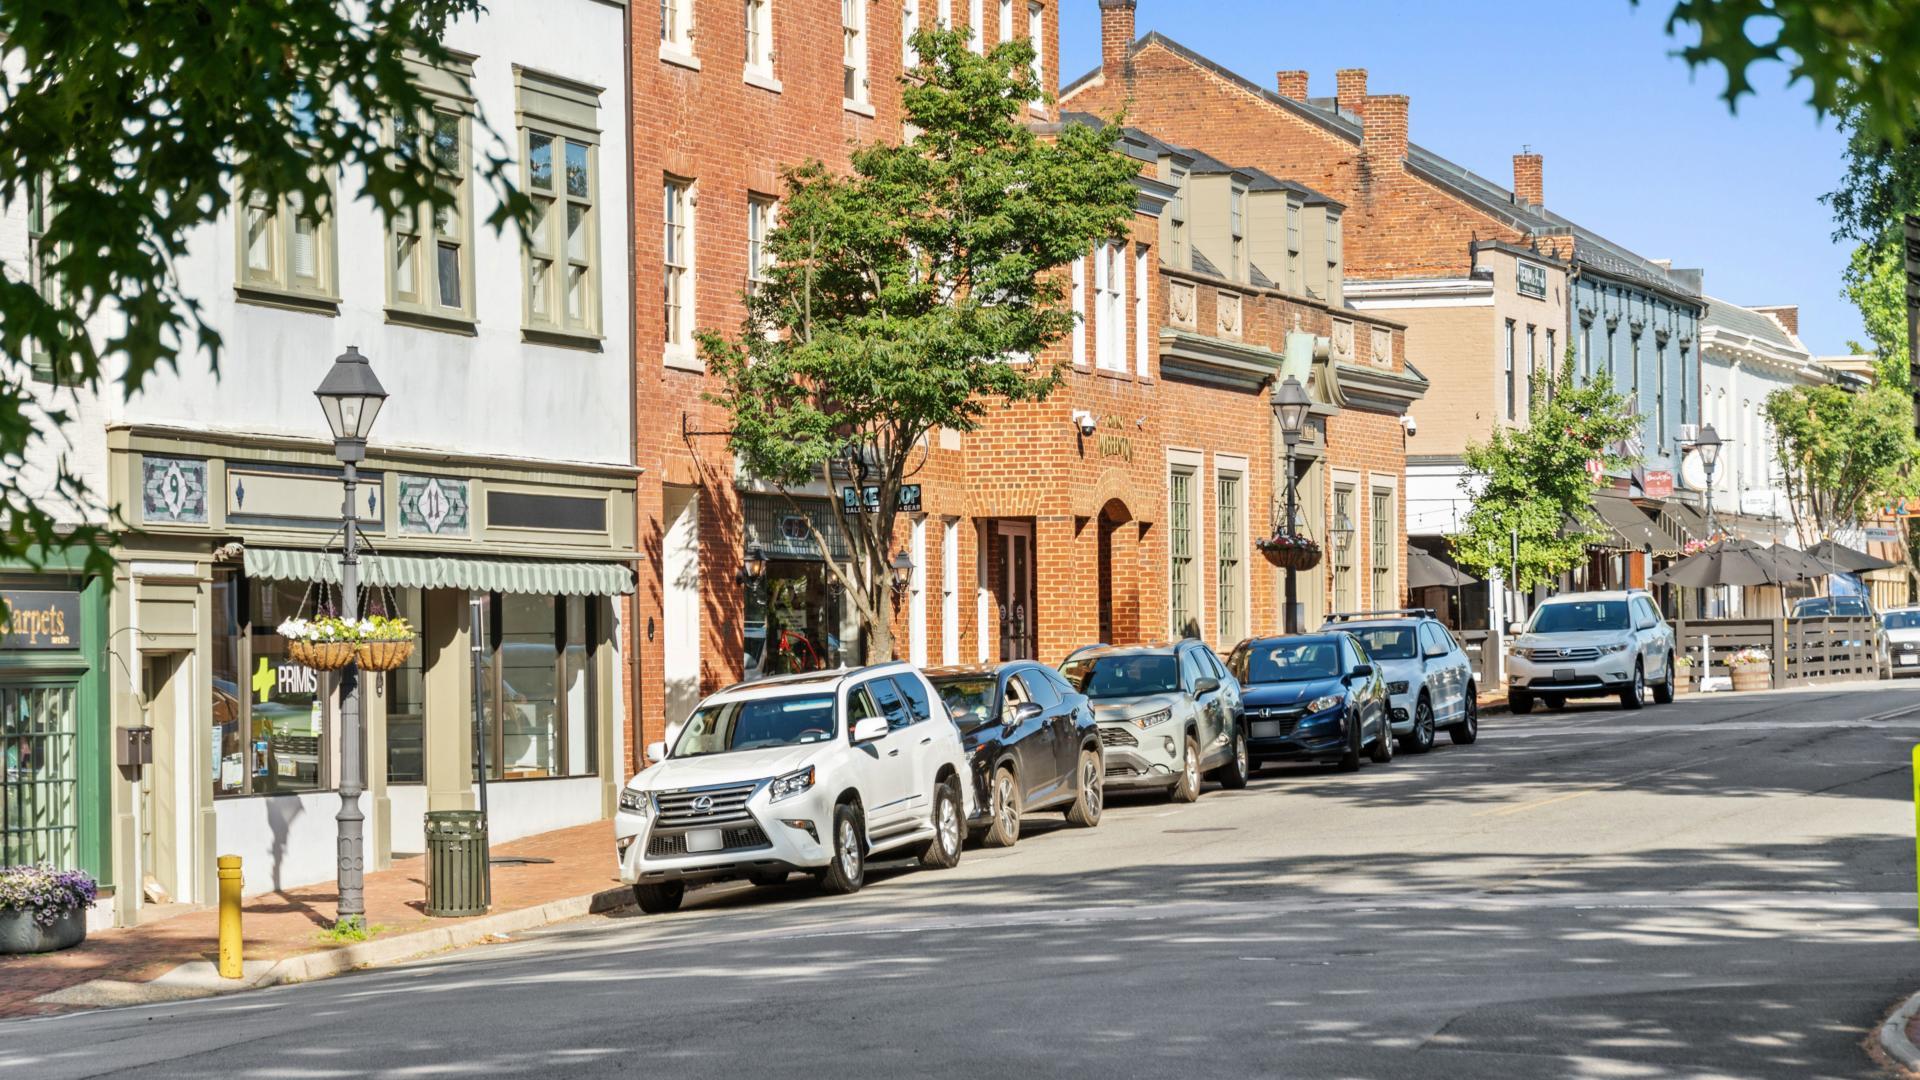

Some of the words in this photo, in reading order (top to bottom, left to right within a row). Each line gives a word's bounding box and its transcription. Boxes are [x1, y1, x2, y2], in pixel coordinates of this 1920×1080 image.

[170, 473, 179, 504] 9
[428, 489, 439, 519] 11
[278, 665, 318, 693] PRIMIS
